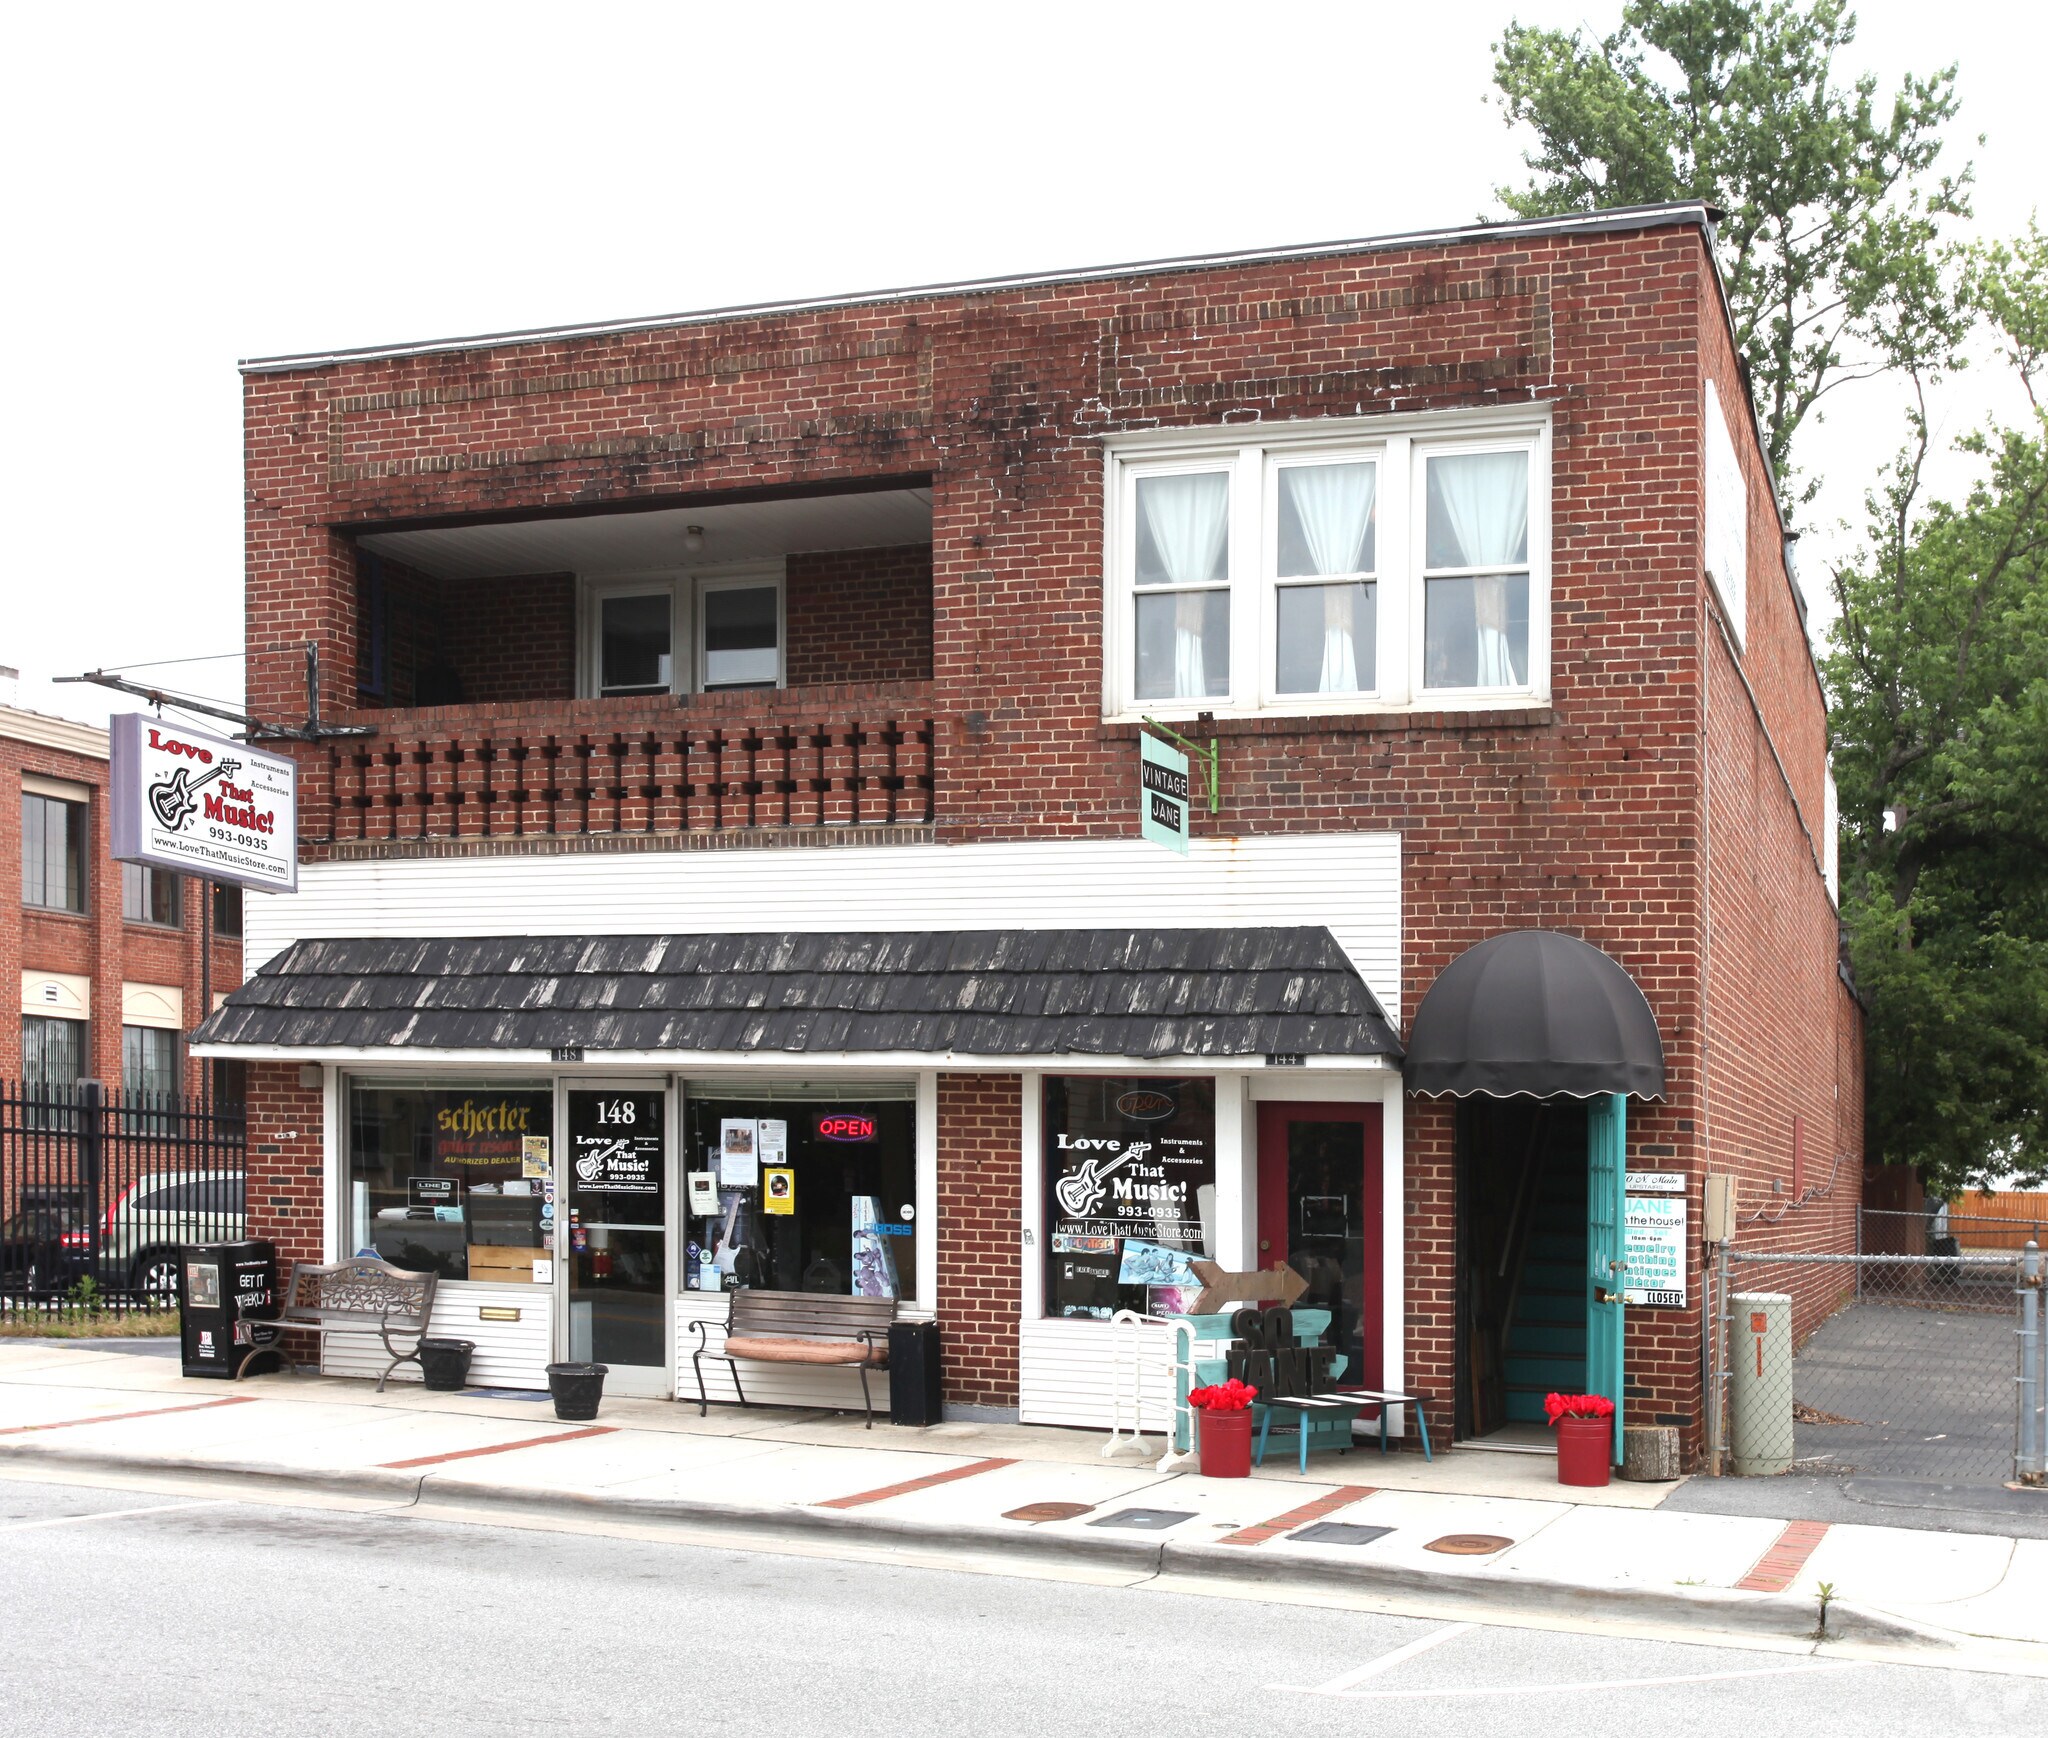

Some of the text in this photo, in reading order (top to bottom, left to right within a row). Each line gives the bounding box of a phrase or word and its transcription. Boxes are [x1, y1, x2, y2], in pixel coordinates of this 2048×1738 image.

[148, 729, 213, 764] Love
[250, 759, 290, 776] Instruments
[267, 774, 273, 782] &
[1143, 765, 1187, 796] VINTAGE
[218, 779, 254, 804] That
[250, 780, 289, 797] Accessories
[203, 792, 274, 835] Music!
[1152, 800, 1179, 827] JANE
[209, 826, 268, 851] 993-0935
[154, 836, 286, 875] www.LoveThatMusicStore.com
[558, 1048, 577, 1061] 148
[1274, 1053, 1297, 1065] 144
[597, 1099, 636, 1125] 148
[819, 1120, 873, 1136] OPEN
[576, 1135, 613, 1145] Love
[1057, 1133, 1121, 1151] Love
[1160, 1137, 1203, 1146] Instruments
[616, 1150, 637, 1159] That
[1161, 1156, 1204, 1165] Accessories
[607, 1158, 649, 1172] Music!
[1128, 1163, 1165, 1178] That
[1625, 1174, 1633, 1182] 0
[1652, 1175, 1678, 1184] Main
[1112, 1176, 1187, 1202] Music!
[1117, 1206, 1181, 1219] 993-0935
[1630, 1216, 1648, 1226] the
[1649, 1217, 1684, 1227] house!
[874, 1224, 912, 1235] BOSS
[1624, 1244, 1676, 1255] ewelry
[1624, 1254, 1677, 1267] lothing
[1625, 1266, 1677, 1277] ntiques
[239, 1274, 265, 1288] GET IT
[1625, 1276, 1665, 1288] Décor
[1647, 1292, 1680, 1304] CLOSED
[1231, 1306, 1294, 1350] SO
[1226, 1345, 1337, 1401] JANE
